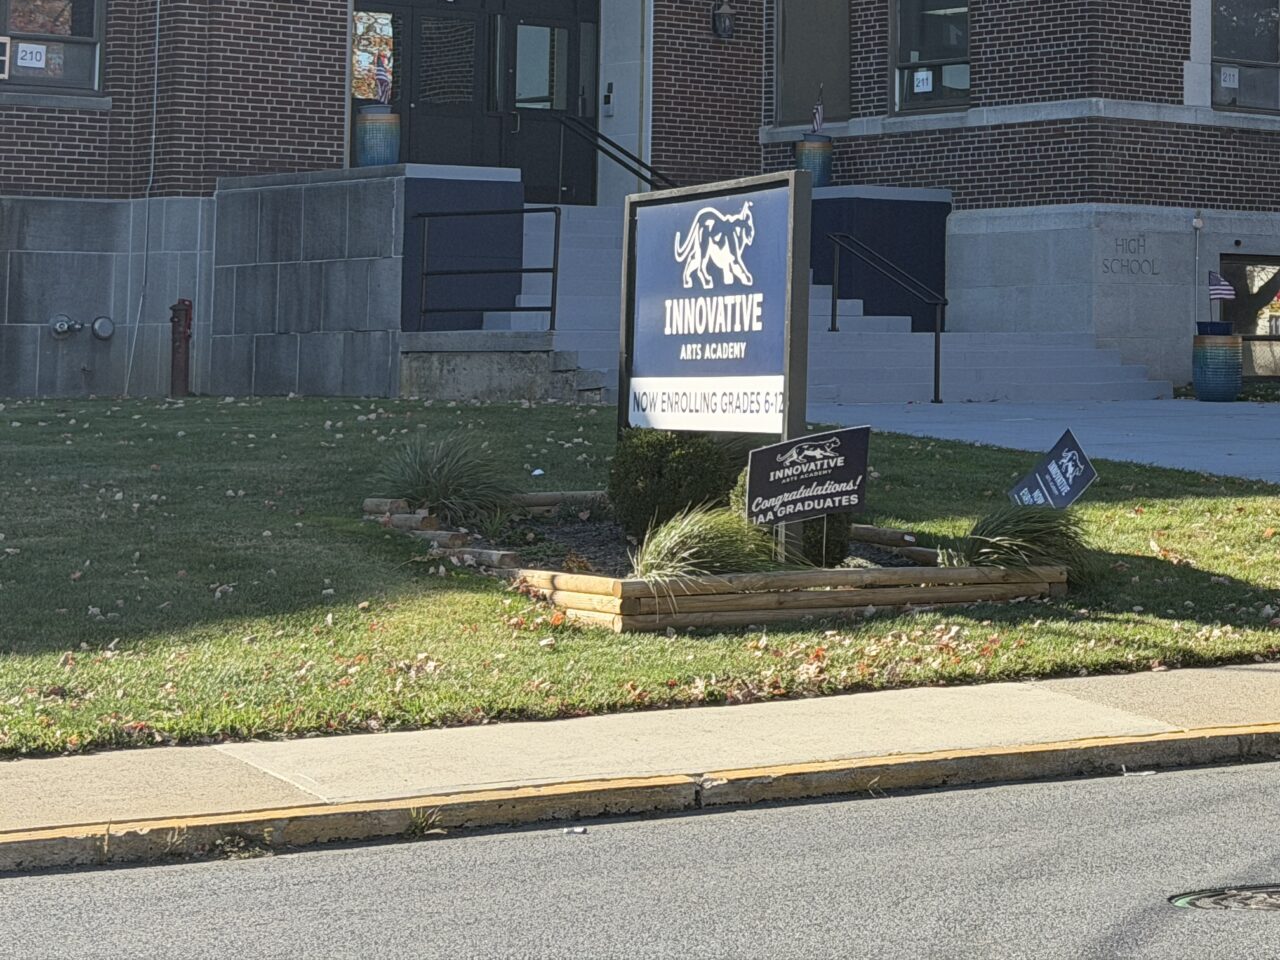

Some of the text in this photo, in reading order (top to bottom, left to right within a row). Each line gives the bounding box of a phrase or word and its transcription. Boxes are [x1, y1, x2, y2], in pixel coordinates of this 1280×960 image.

[20, 49, 42, 62] 210
[916, 76, 929, 88] 211
[1223, 71, 1236, 83] 211
[1114, 237, 1146, 254] HIGH
[1102, 258, 1160, 275] SCHOOL
[664, 293, 763, 335] INNOVATIVE
[680, 342, 747, 360] ARTS ACADEMY
[633, 391, 784, 414] NOW ENROLLING GRADES 6-12
[769, 456, 845, 481] INNOVATIVE
[800, 469, 833, 480] ACADEMY
[751, 475, 863, 512] Congratulations!
[777, 494, 859, 517] GRADUATES
